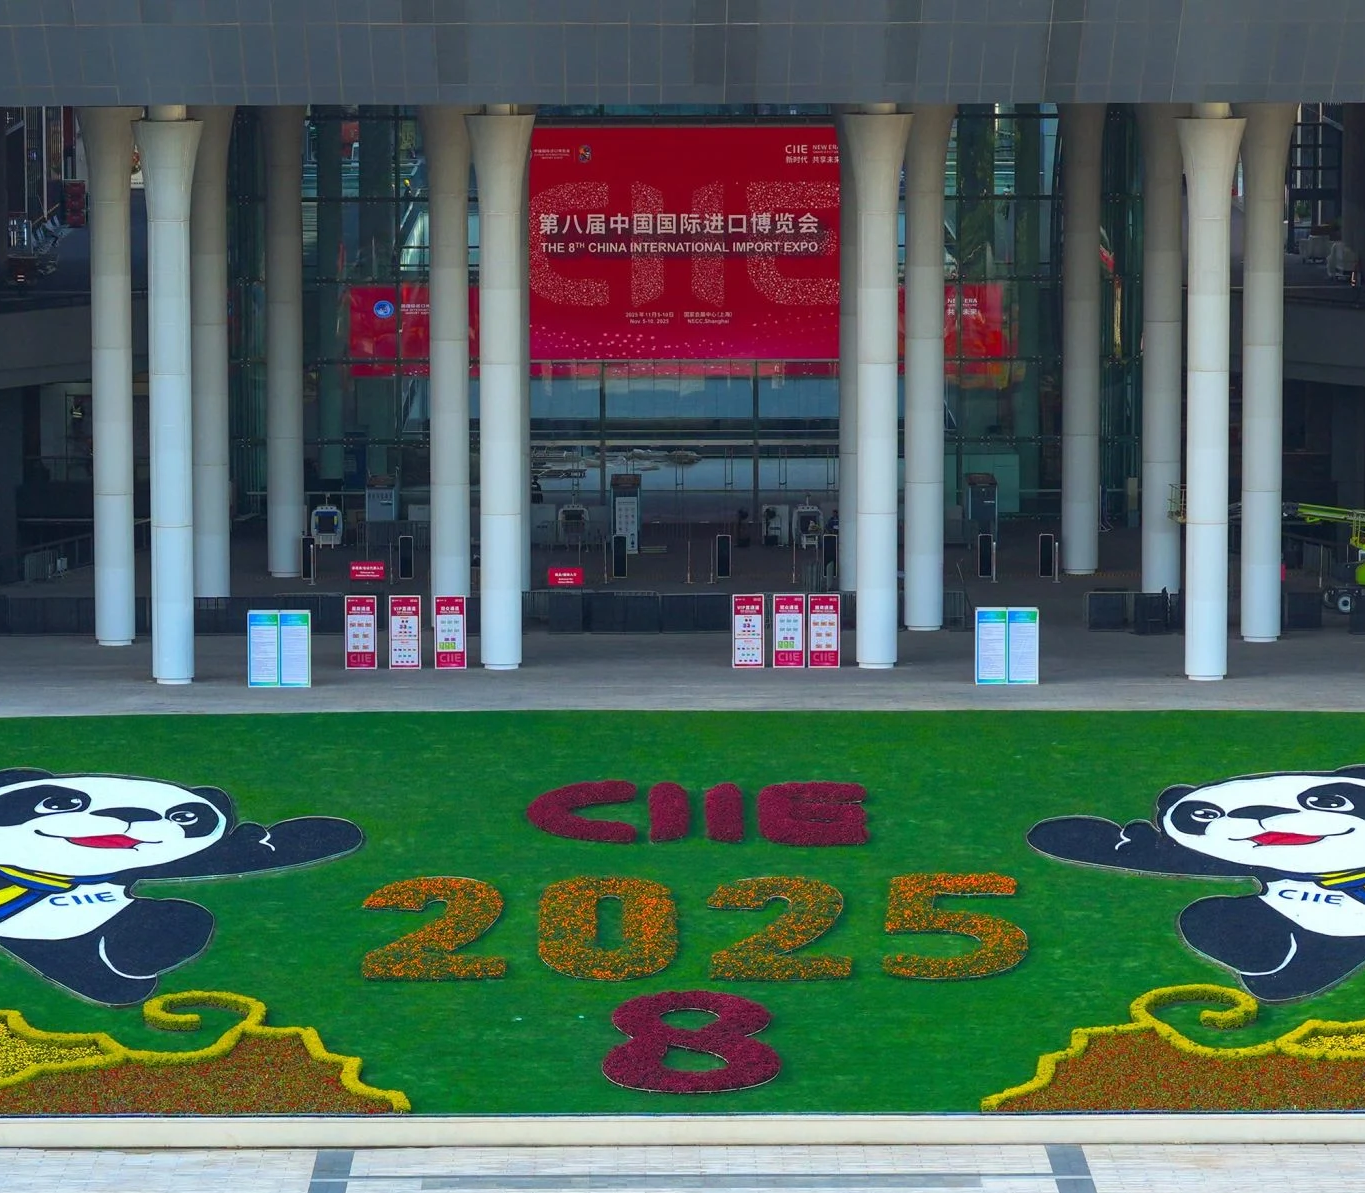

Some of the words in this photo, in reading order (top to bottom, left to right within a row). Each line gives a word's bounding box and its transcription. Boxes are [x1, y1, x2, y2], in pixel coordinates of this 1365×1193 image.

[785, 144, 808, 154] CIIE
[539, 213, 819, 234] 第八届中国国际进口博览会
[541, 242, 565, 252] THE
[568, 242, 585, 253] 8TH
[588, 242, 628, 253] CHINA
[630, 242, 729, 252] INTERNATIONAL
[733, 242, 781, 252] IMPORT
[784, 242, 819, 252] EXPO
[350, 654, 371, 662] CIIE
[440, 654, 461, 662] CIIE
[778, 652, 800, 661] CIIE
[813, 652, 835, 661] CIIE
[526, 780, 870, 847] CIIE
[49, 892, 116, 906] CIIE
[1278, 889, 1344, 905] CIIE
[361, 873, 1029, 981] 2025
[601, 990, 781, 1094] 8
